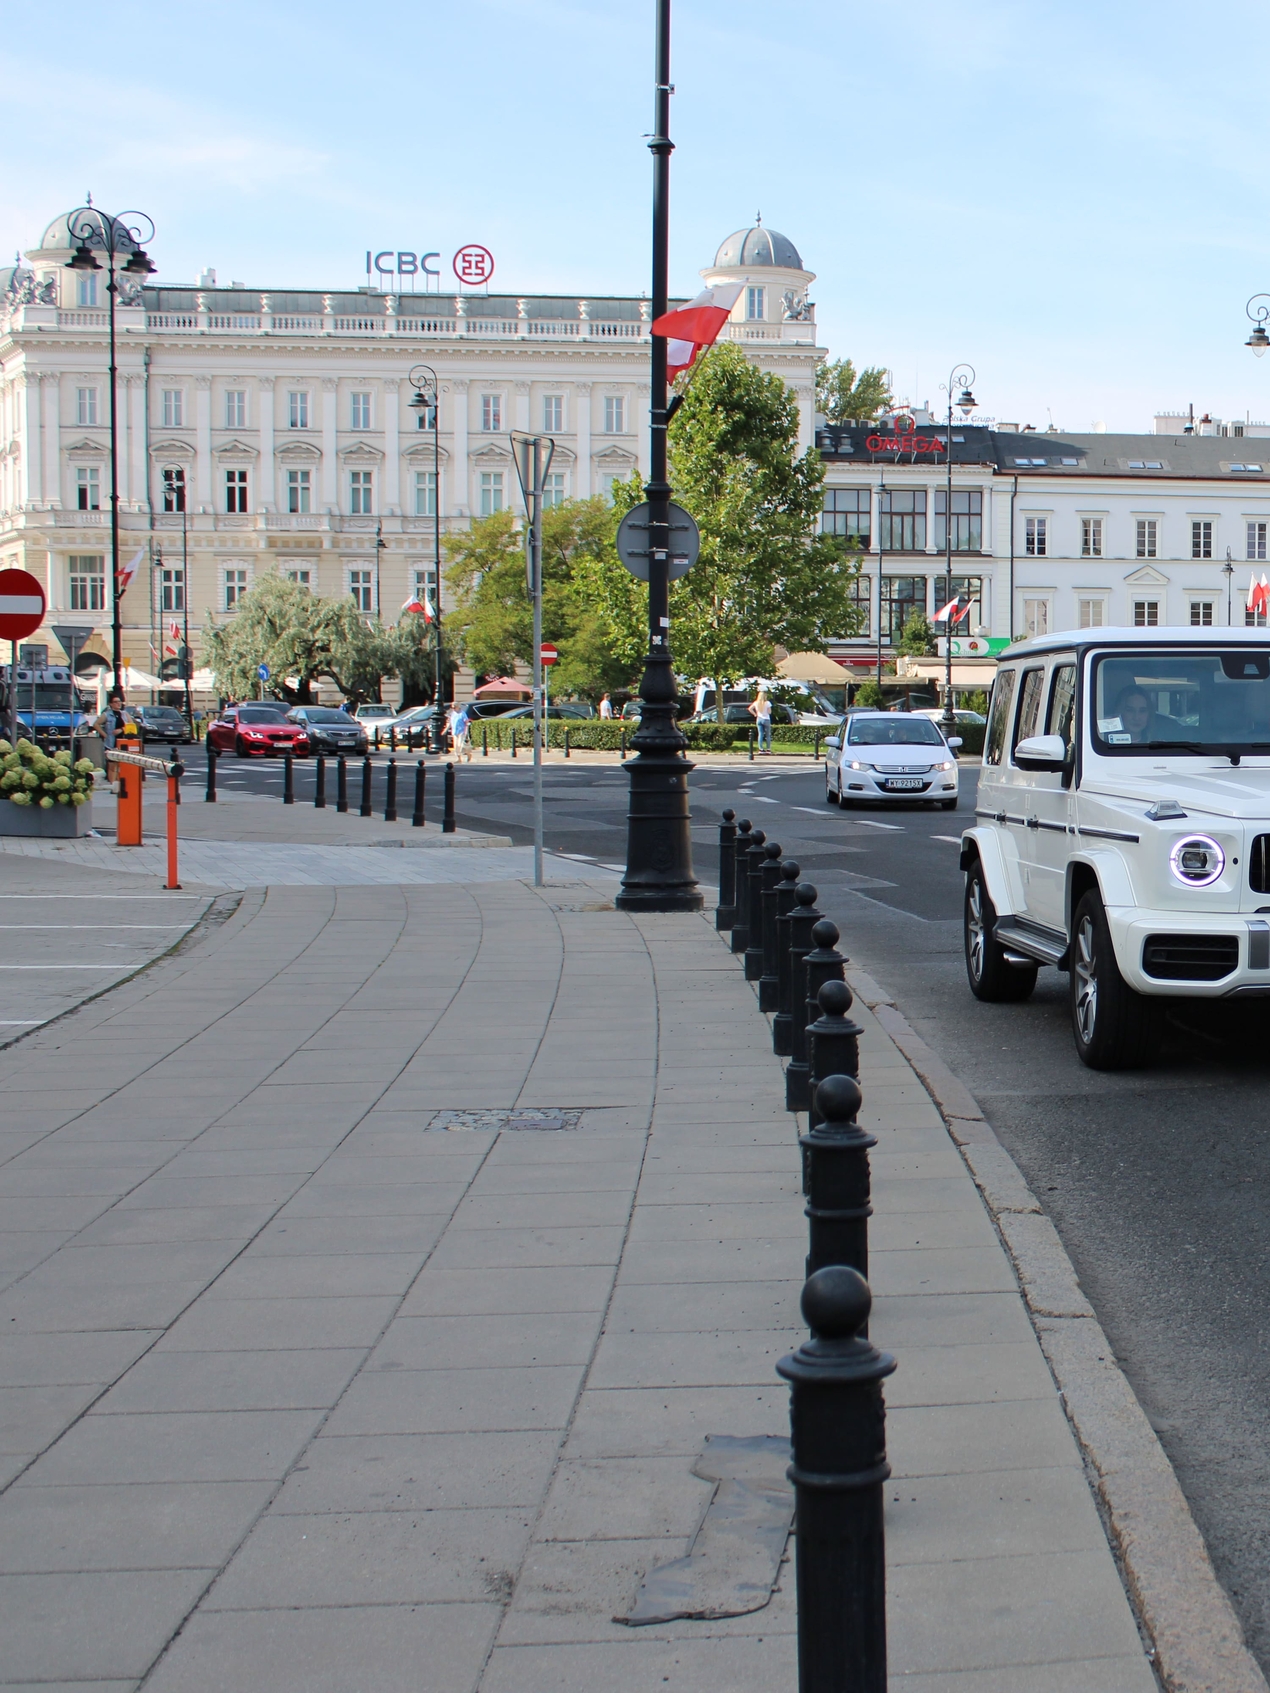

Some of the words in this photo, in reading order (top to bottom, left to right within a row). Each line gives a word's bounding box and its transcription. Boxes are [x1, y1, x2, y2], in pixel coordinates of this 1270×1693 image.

[366, 251, 440, 275] ICBC
[971, 415, 995, 424] Grupa
[866, 435, 944, 452] OMEGA
